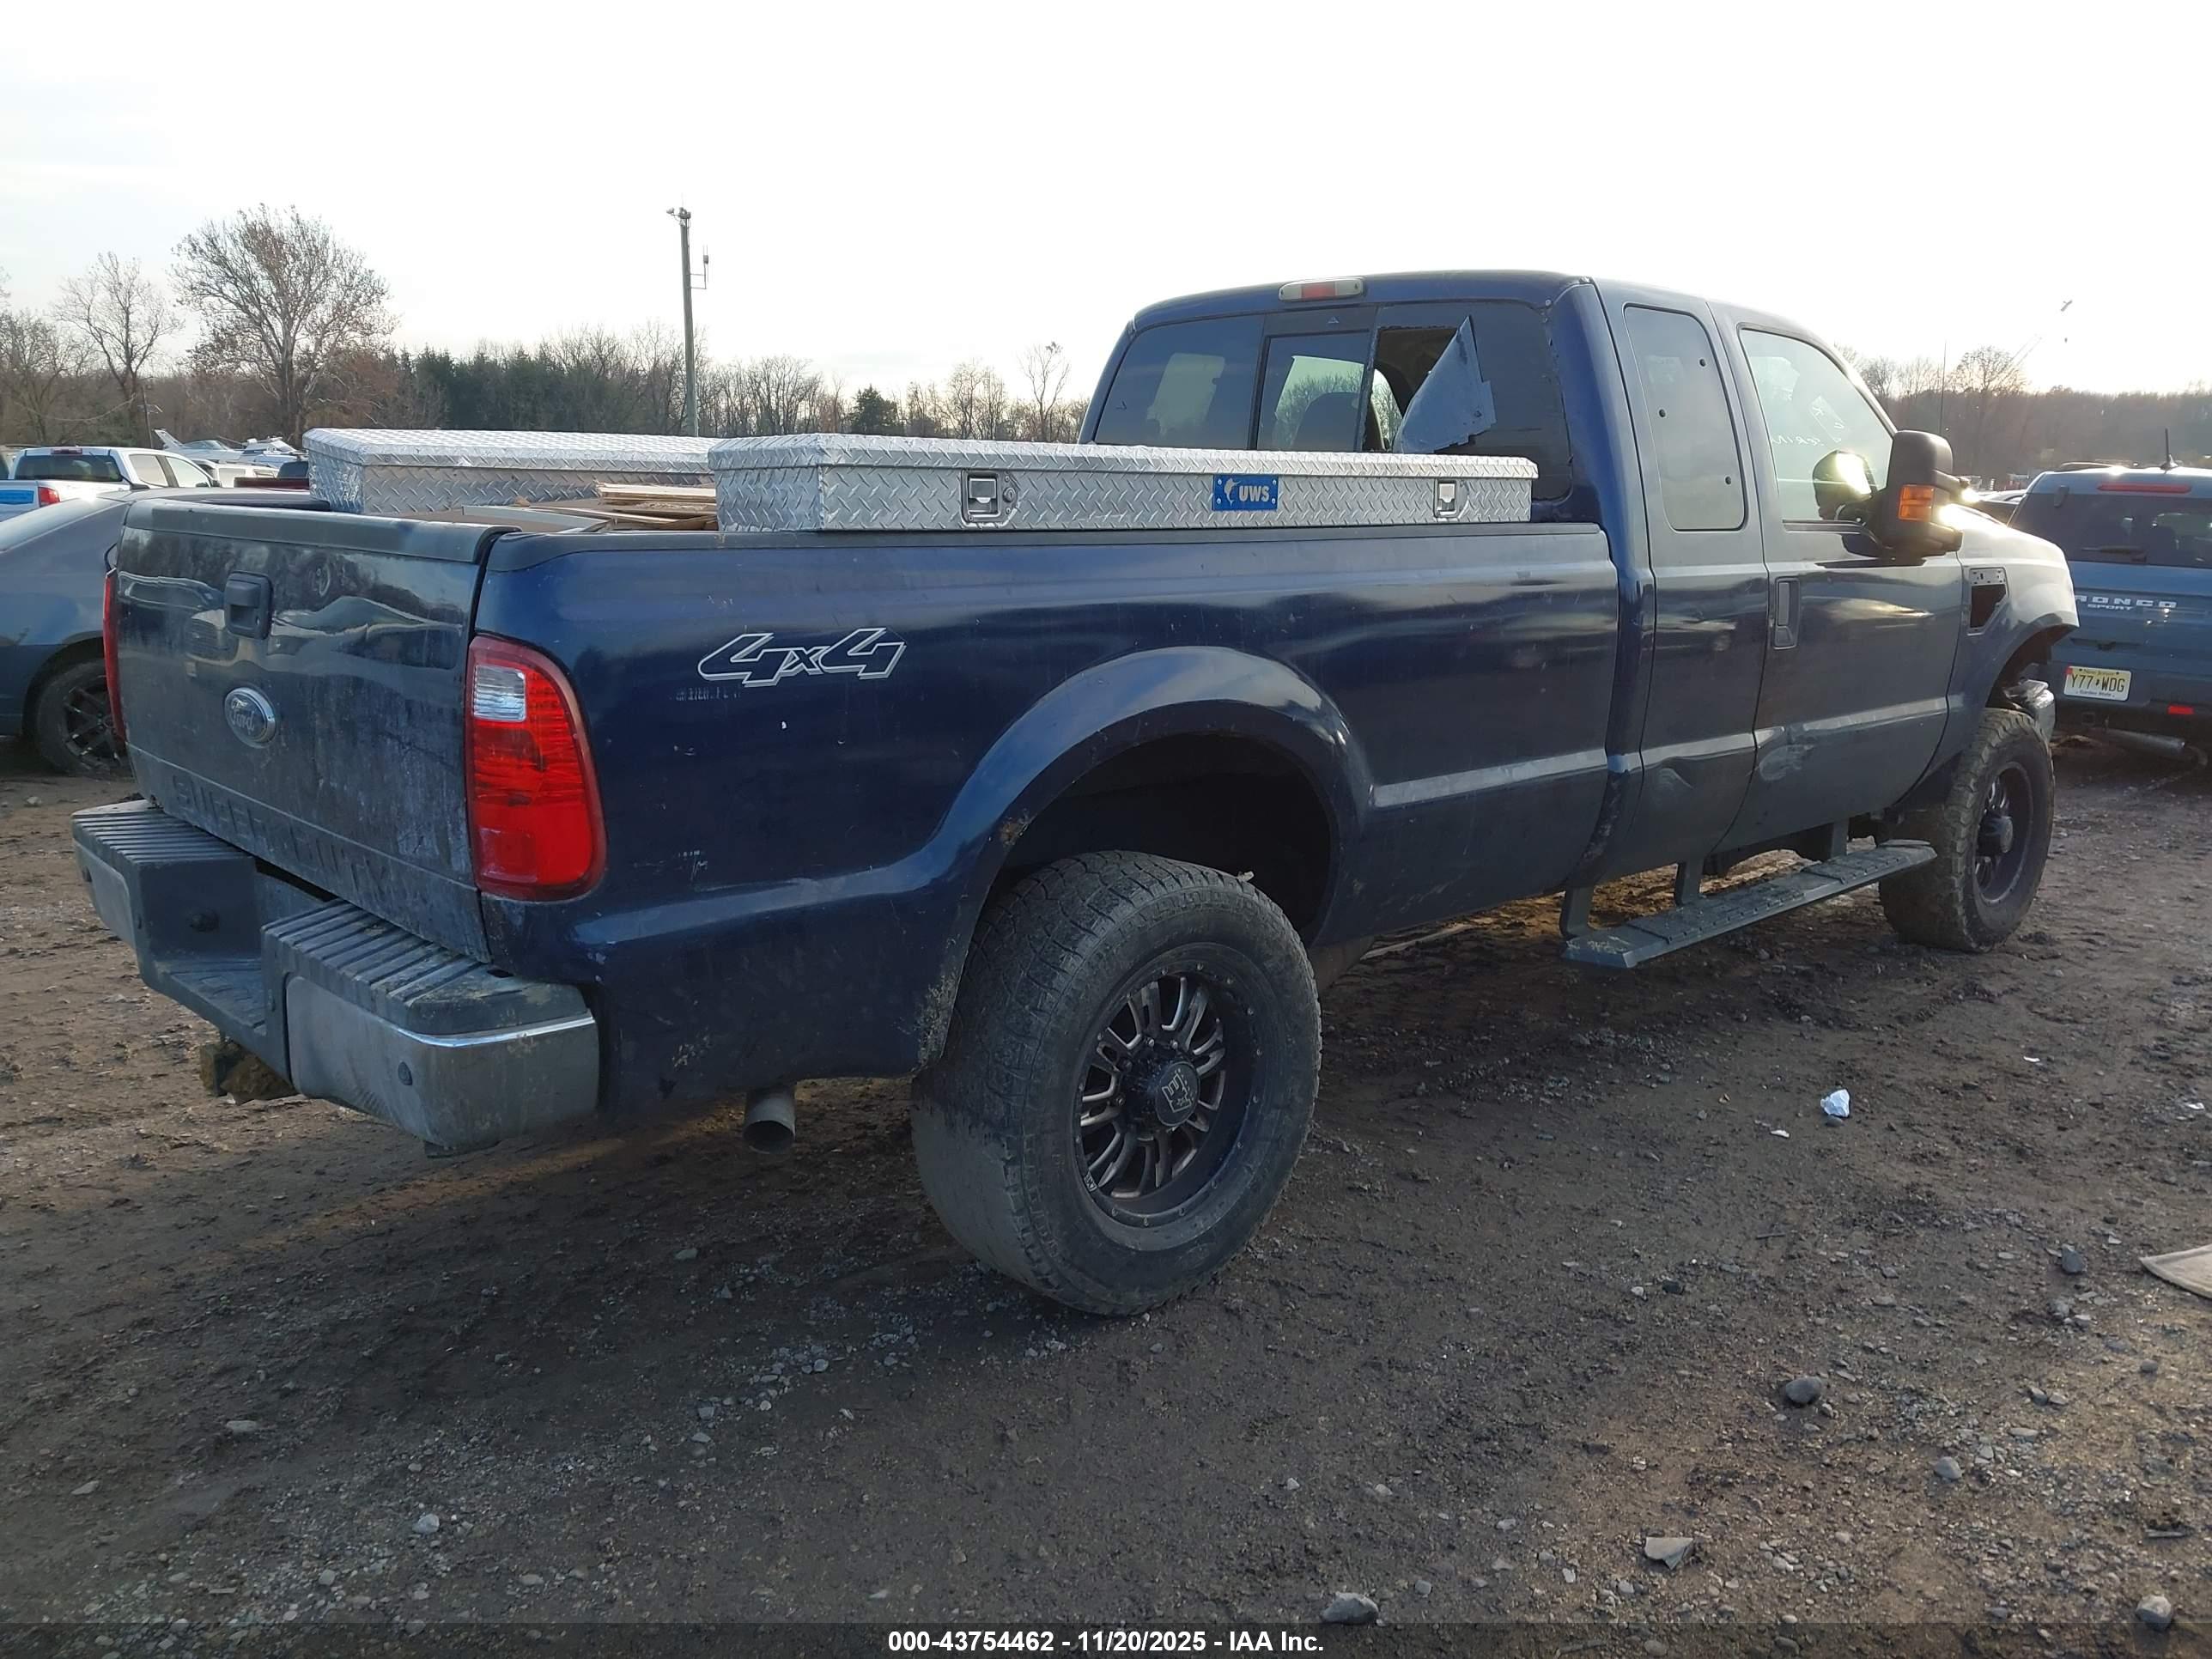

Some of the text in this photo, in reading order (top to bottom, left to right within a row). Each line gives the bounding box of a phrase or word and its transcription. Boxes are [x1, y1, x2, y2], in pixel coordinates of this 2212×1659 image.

[1239, 485, 1270, 502] UWS
[2074, 595, 2177, 608] RONCO
[697, 627, 908, 688] 4x4
